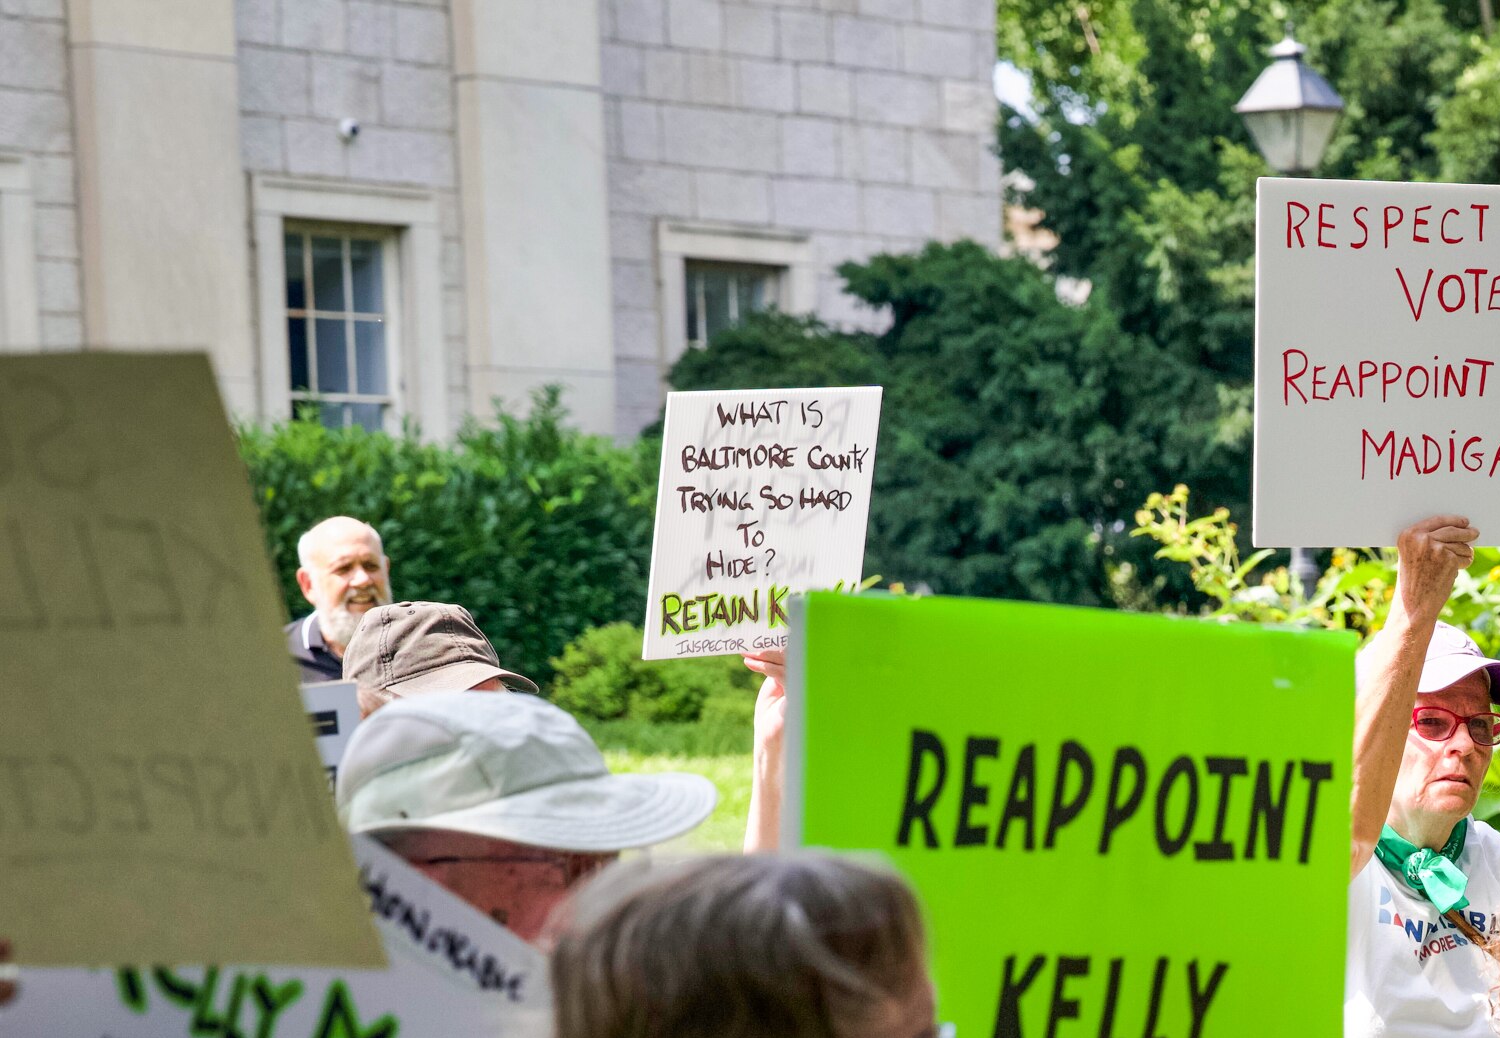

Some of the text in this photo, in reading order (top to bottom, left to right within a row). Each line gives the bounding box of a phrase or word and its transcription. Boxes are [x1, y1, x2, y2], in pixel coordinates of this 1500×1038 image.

[1287, 201, 1490, 249] RESPECT
[717, 400, 823, 428] WHAT IS
[682, 443, 798, 473] BALTIMORE
[676, 485, 852, 514] TRYING SO HARD
[737, 521, 764, 547] TO
[706, 549, 776, 580] HIDE?
[661, 589, 759, 636] RETAIN
[675, 639, 748, 655] INSPECTOR
[895, 729, 1333, 864] REAPPOINT
